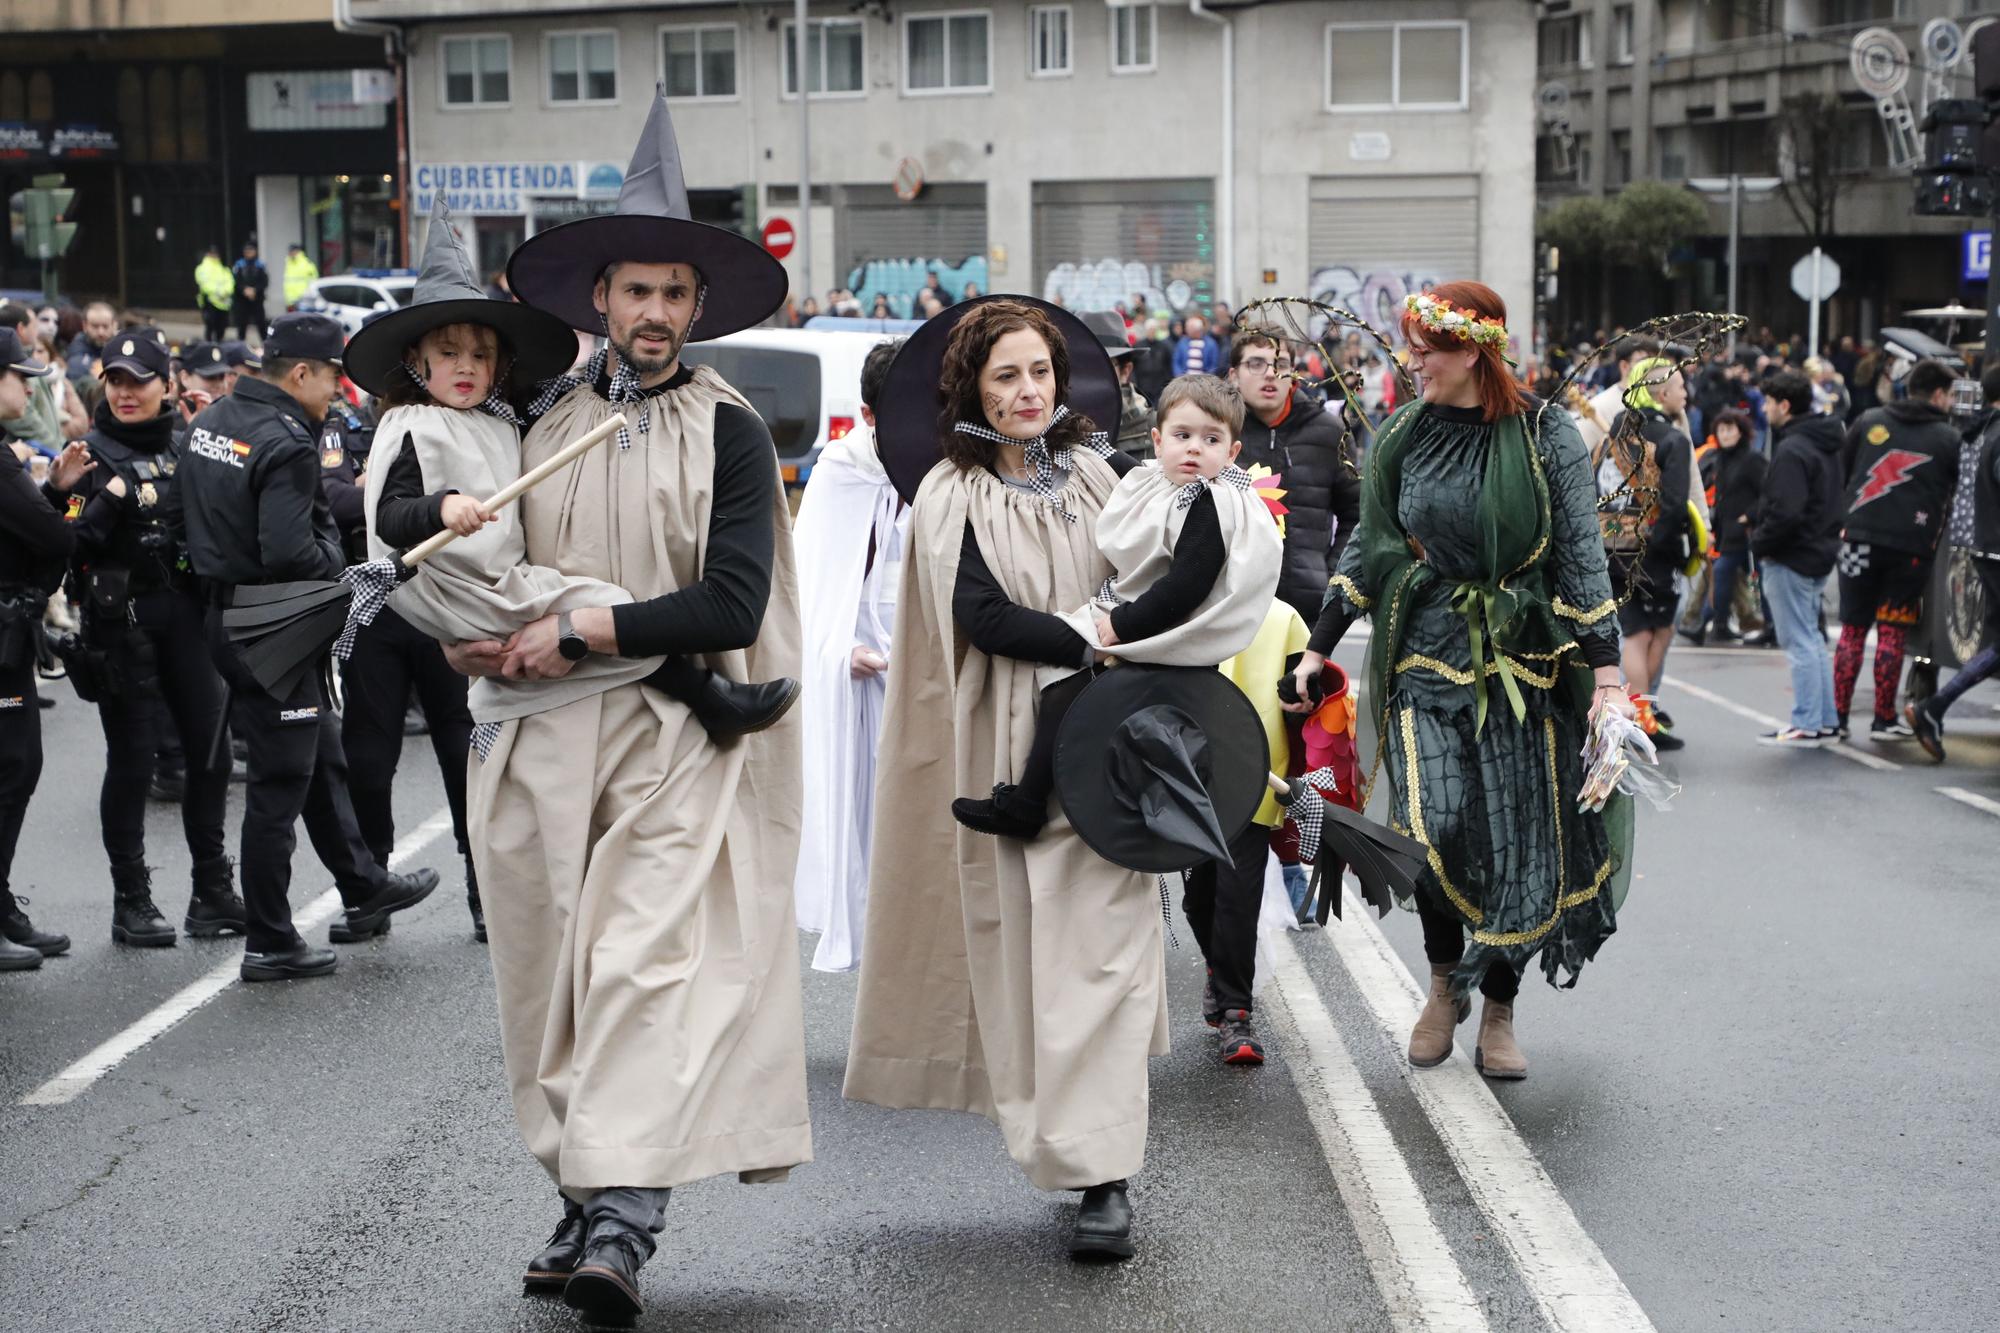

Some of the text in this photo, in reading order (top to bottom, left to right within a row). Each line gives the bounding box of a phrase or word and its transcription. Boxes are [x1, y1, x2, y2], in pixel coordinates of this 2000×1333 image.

[418, 166, 574, 189] CUBRETENDA
[418, 193, 519, 210] MMPARAS
[189, 440, 244, 468] NACIONAL
